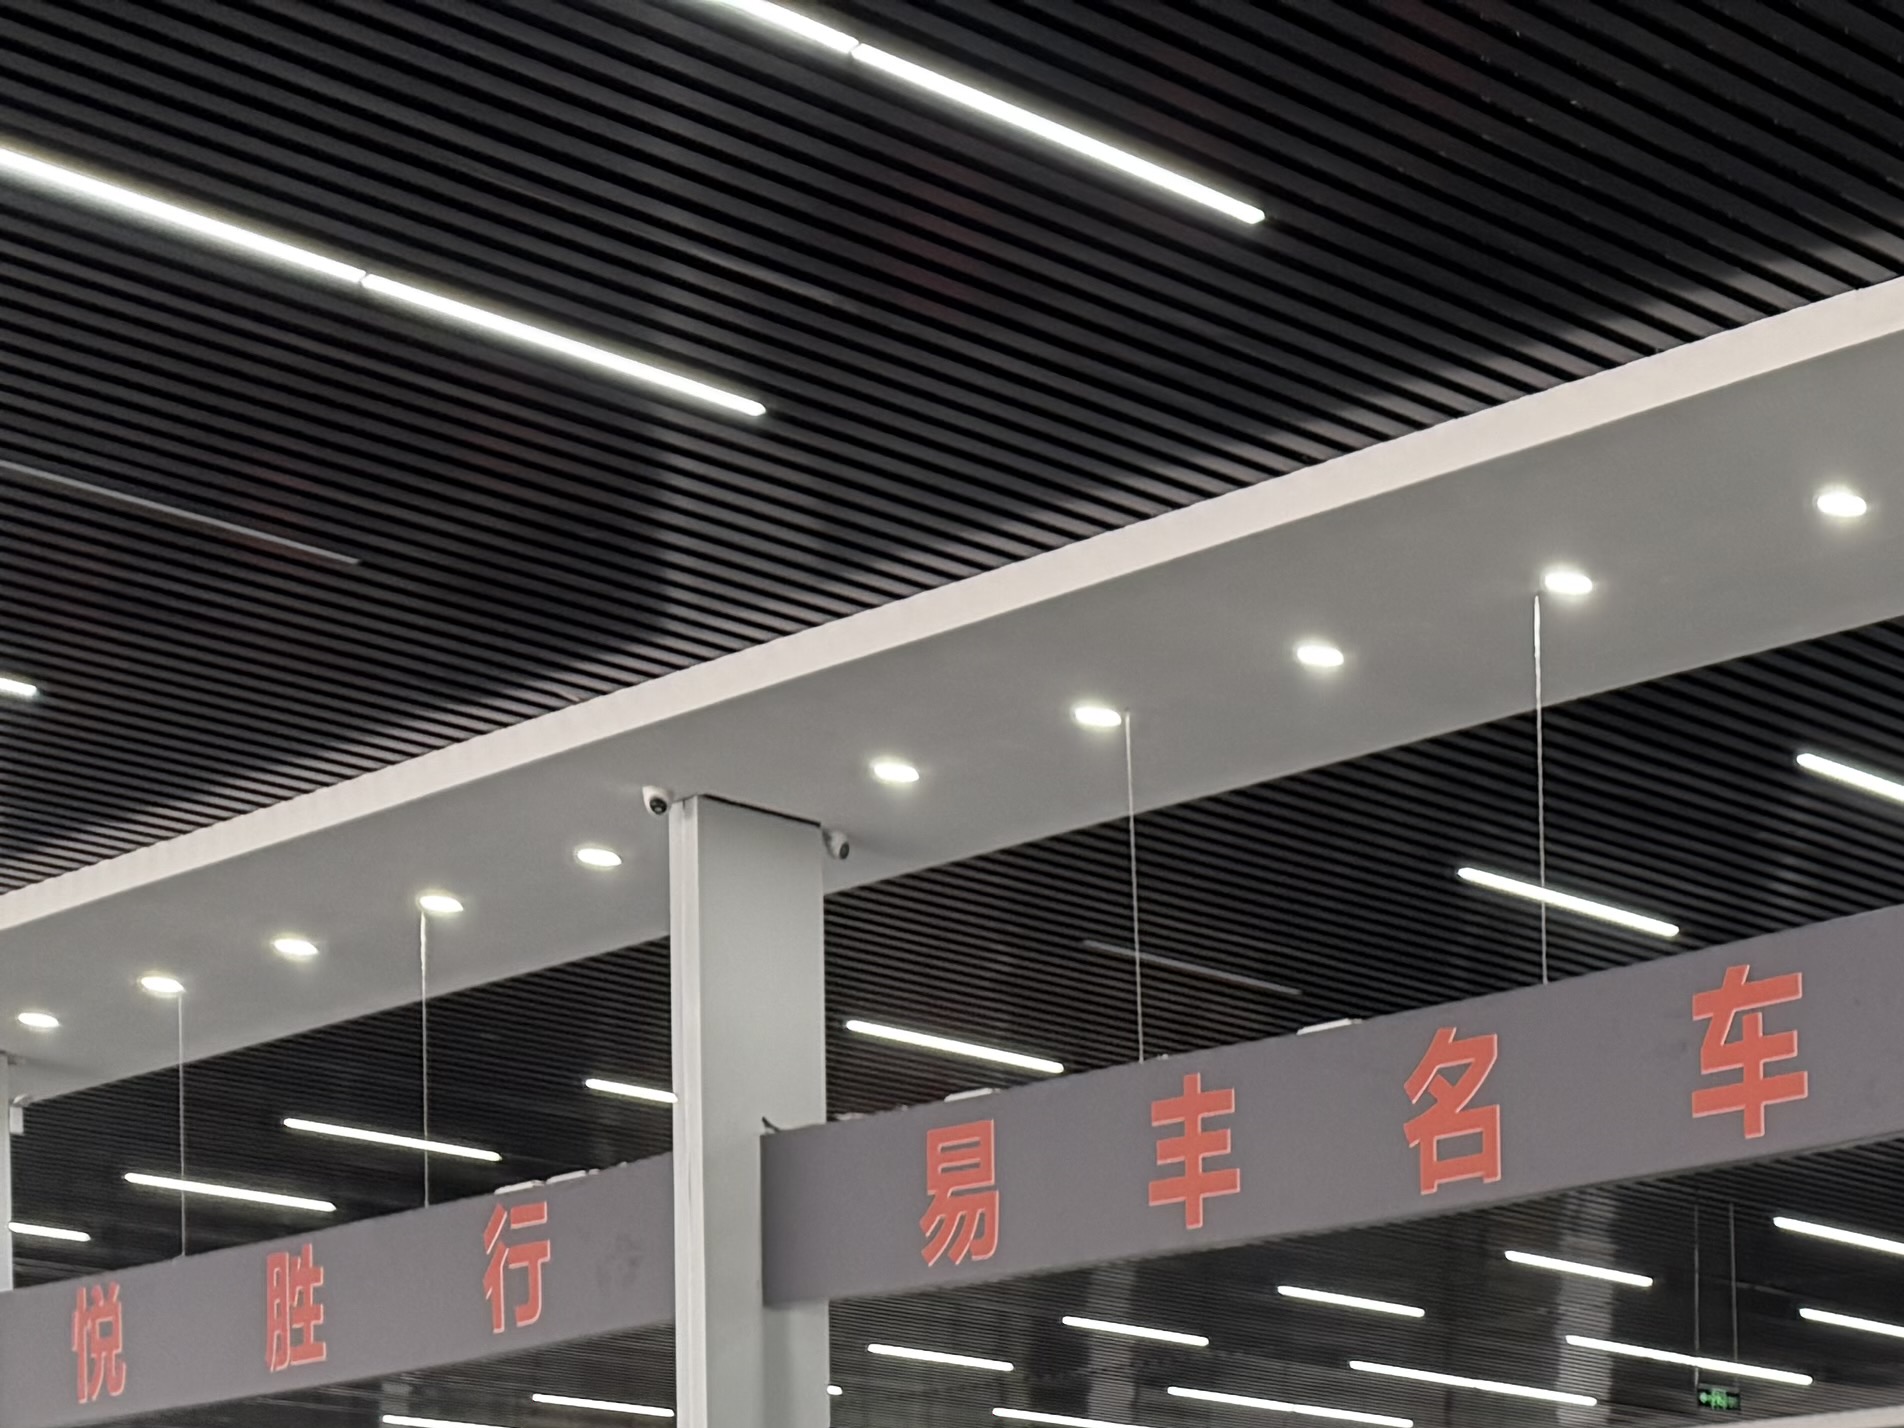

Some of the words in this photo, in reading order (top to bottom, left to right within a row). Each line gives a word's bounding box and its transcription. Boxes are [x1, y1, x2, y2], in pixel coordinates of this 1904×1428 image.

[919, 964, 1810, 1267] 易丰名车
[71, 1200, 552, 1404] 悦胜行
